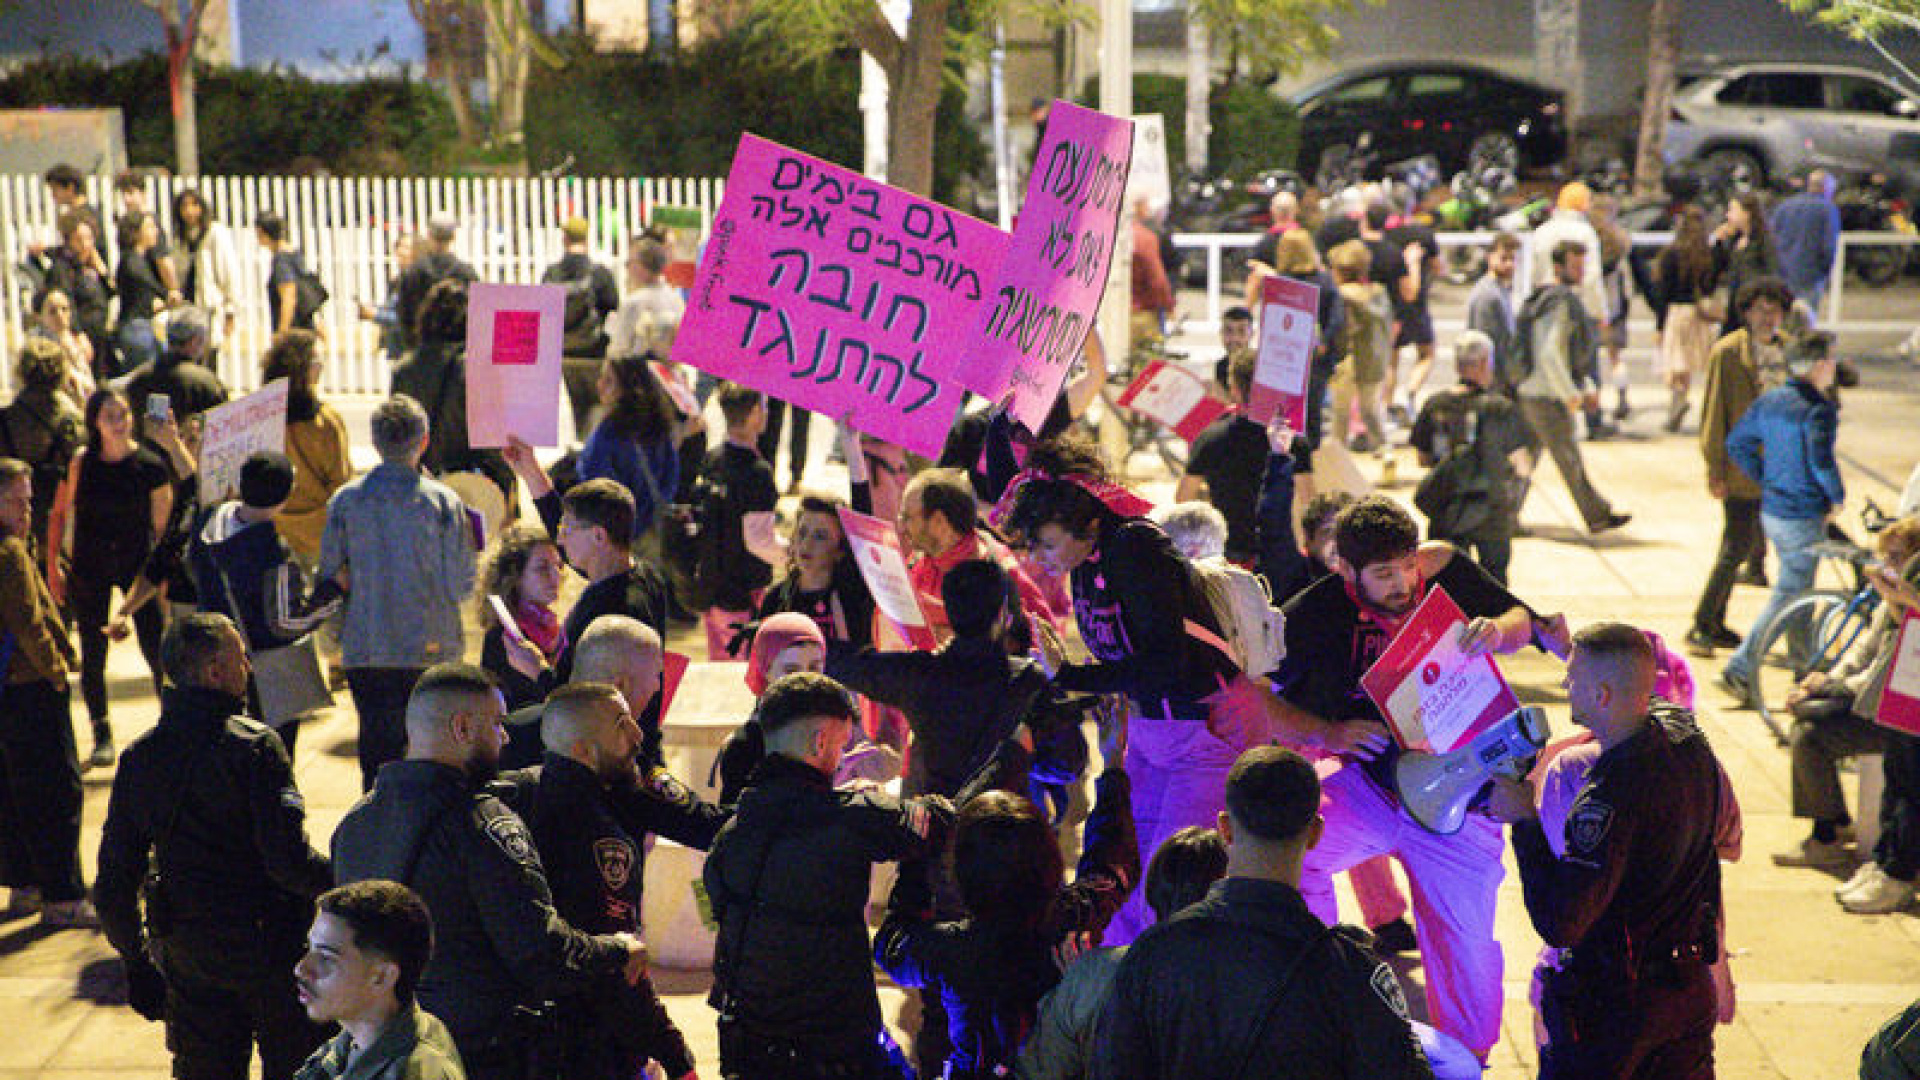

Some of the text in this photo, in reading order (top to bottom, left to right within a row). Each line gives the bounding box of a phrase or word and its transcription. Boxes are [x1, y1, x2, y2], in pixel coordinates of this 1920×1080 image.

[751, 194, 981, 301] מורכבים אלה
[772, 157, 958, 249] גם בימים
[768, 248, 930, 344] חובה
[729, 295, 939, 414] להתנגד
